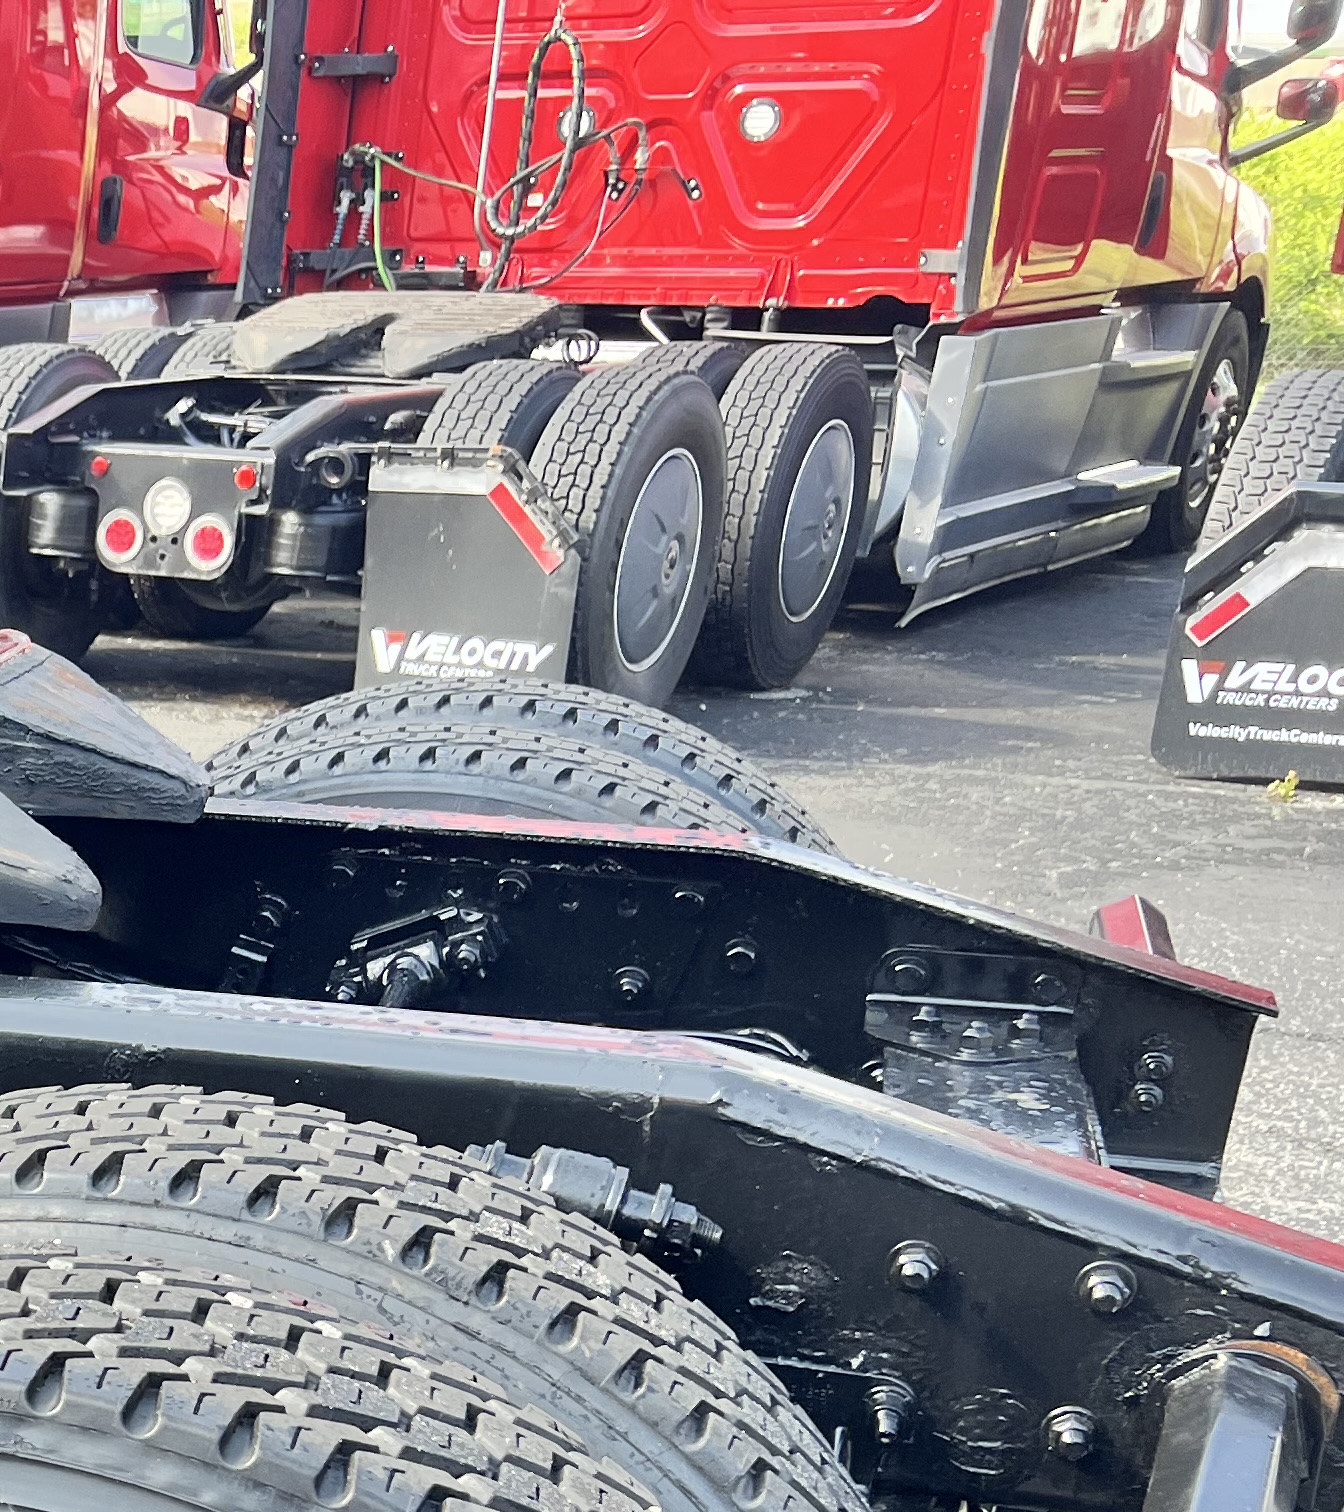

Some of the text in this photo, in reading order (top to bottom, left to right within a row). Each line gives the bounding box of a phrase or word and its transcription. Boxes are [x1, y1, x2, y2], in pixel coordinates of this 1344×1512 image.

[403, 630, 558, 673] VELOCITY
[399, 661, 439, 678] TRUCK
[1216, 690, 1339, 712] TRUCK CENTERS
